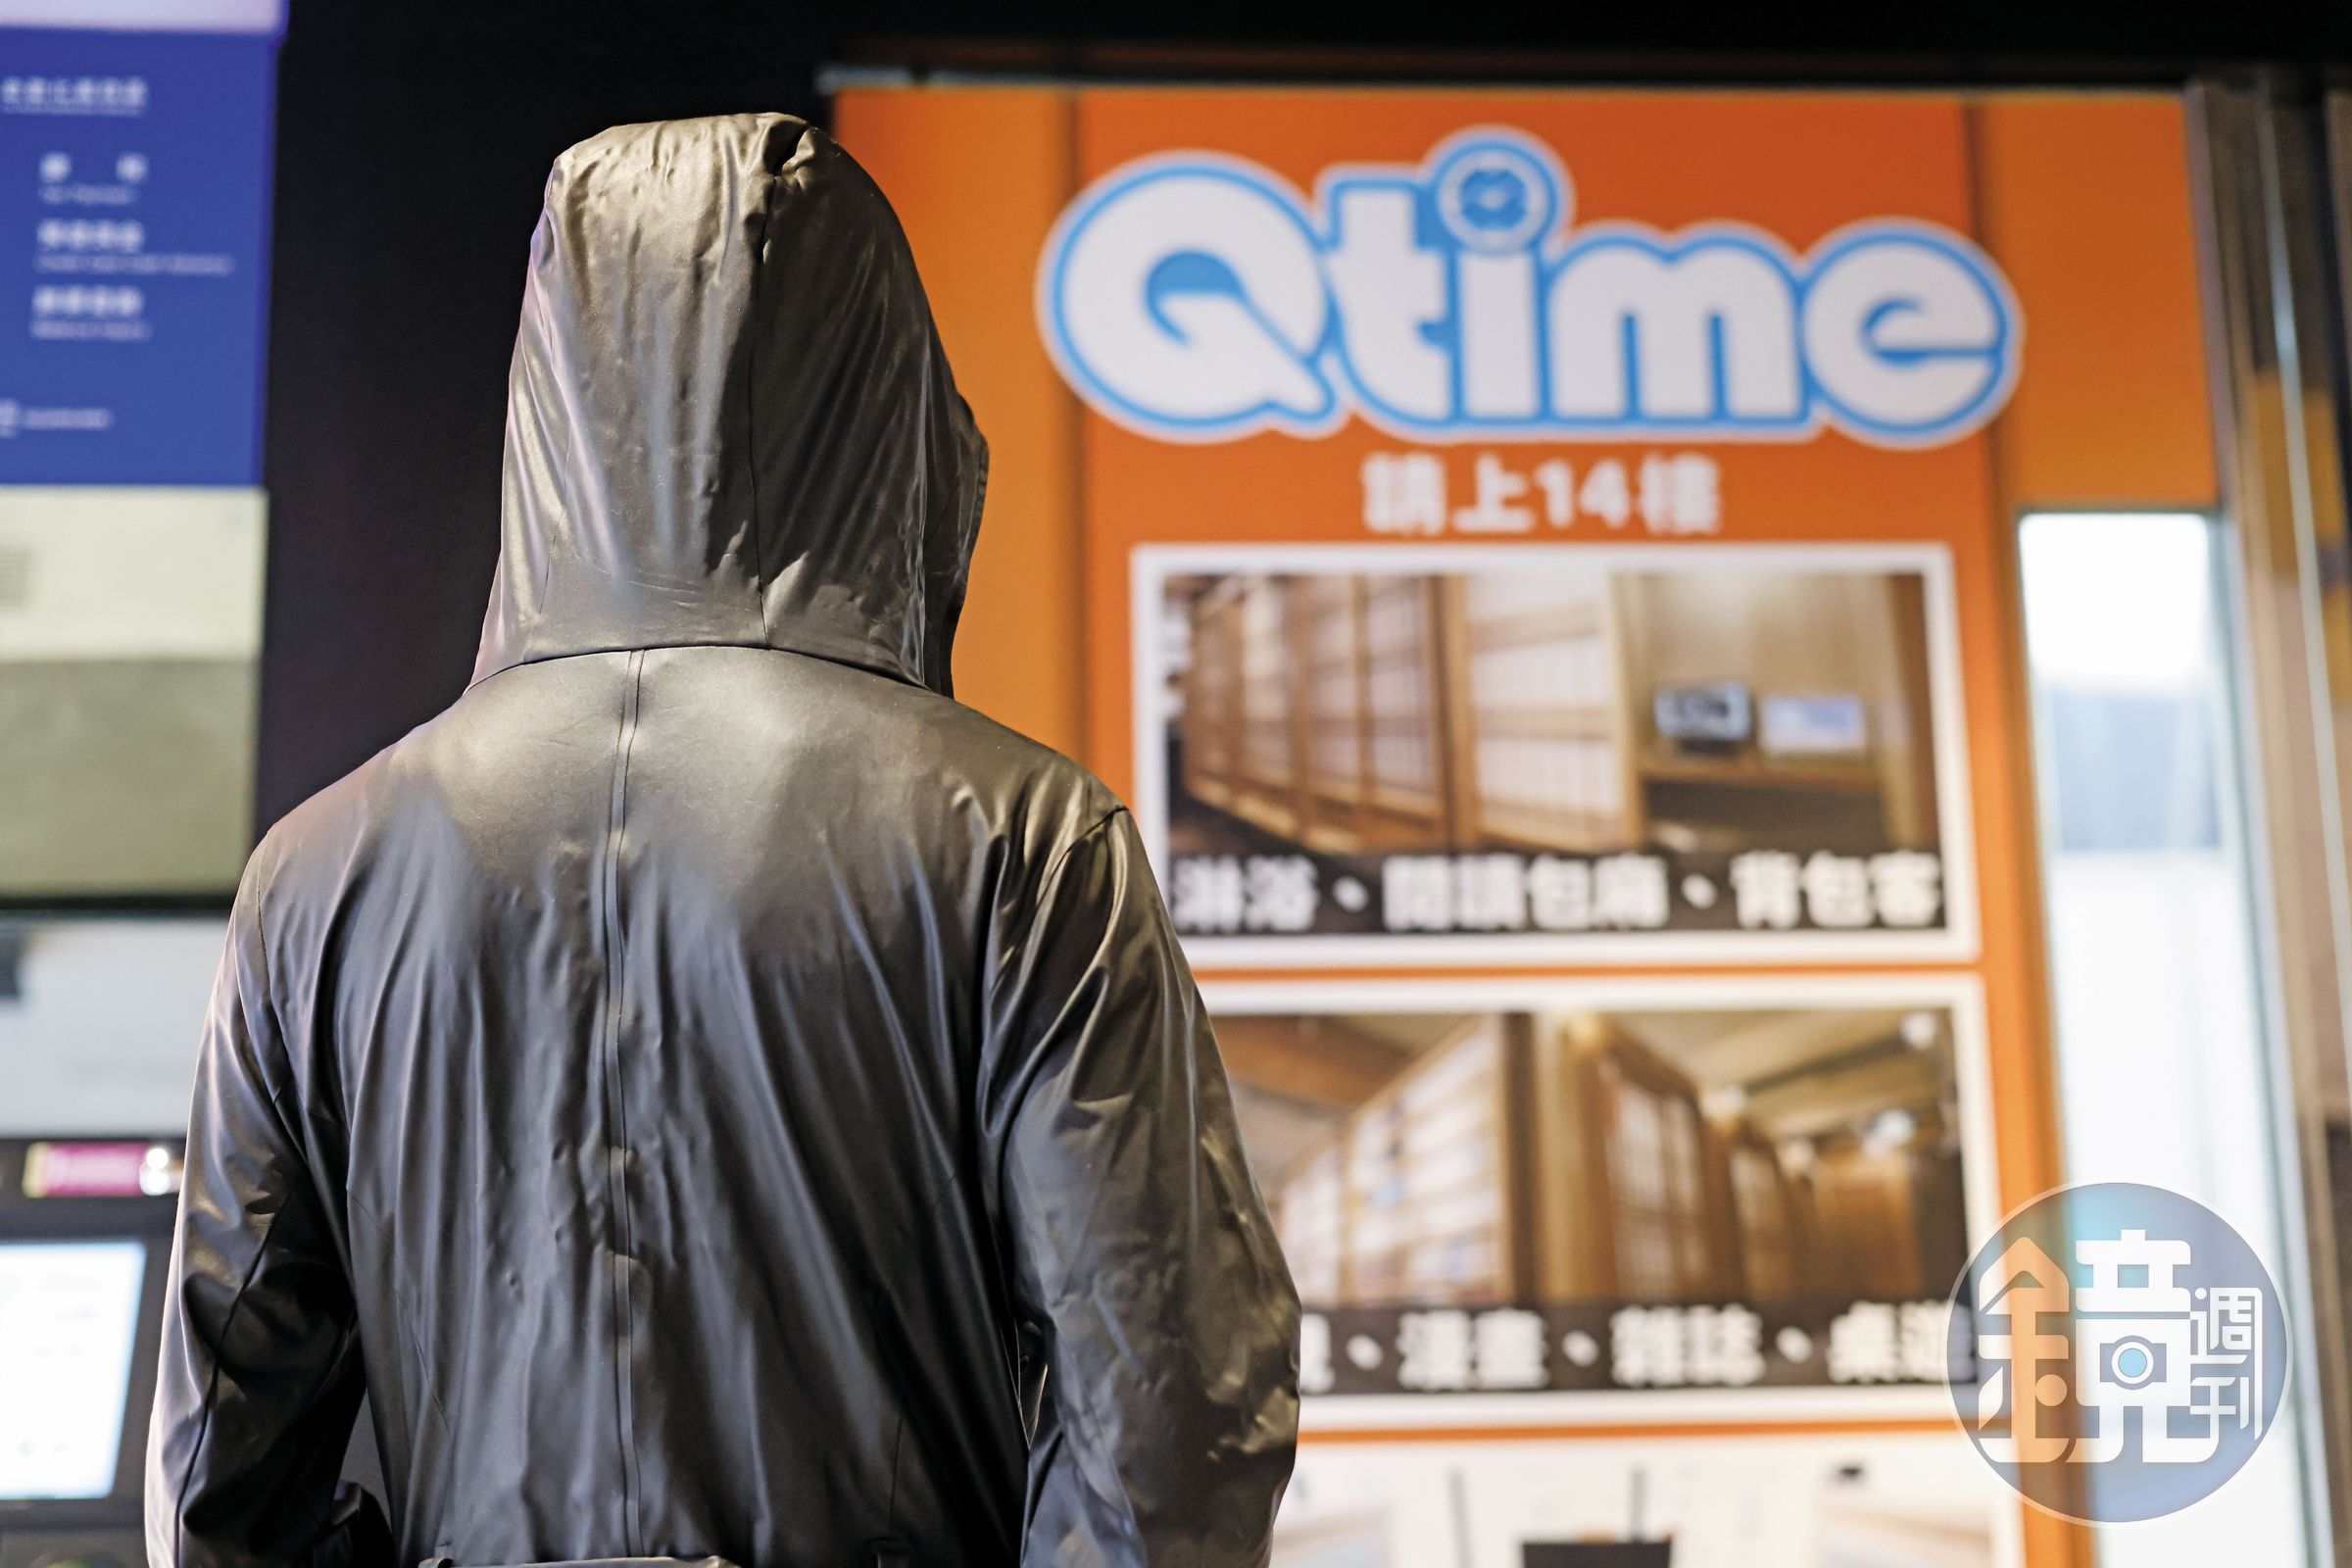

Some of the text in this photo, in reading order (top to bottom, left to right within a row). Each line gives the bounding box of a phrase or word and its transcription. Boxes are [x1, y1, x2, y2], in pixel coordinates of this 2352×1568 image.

[1049, 135, 2013, 439] Qtime
[1361, 453, 1721, 535] 請上14樓
